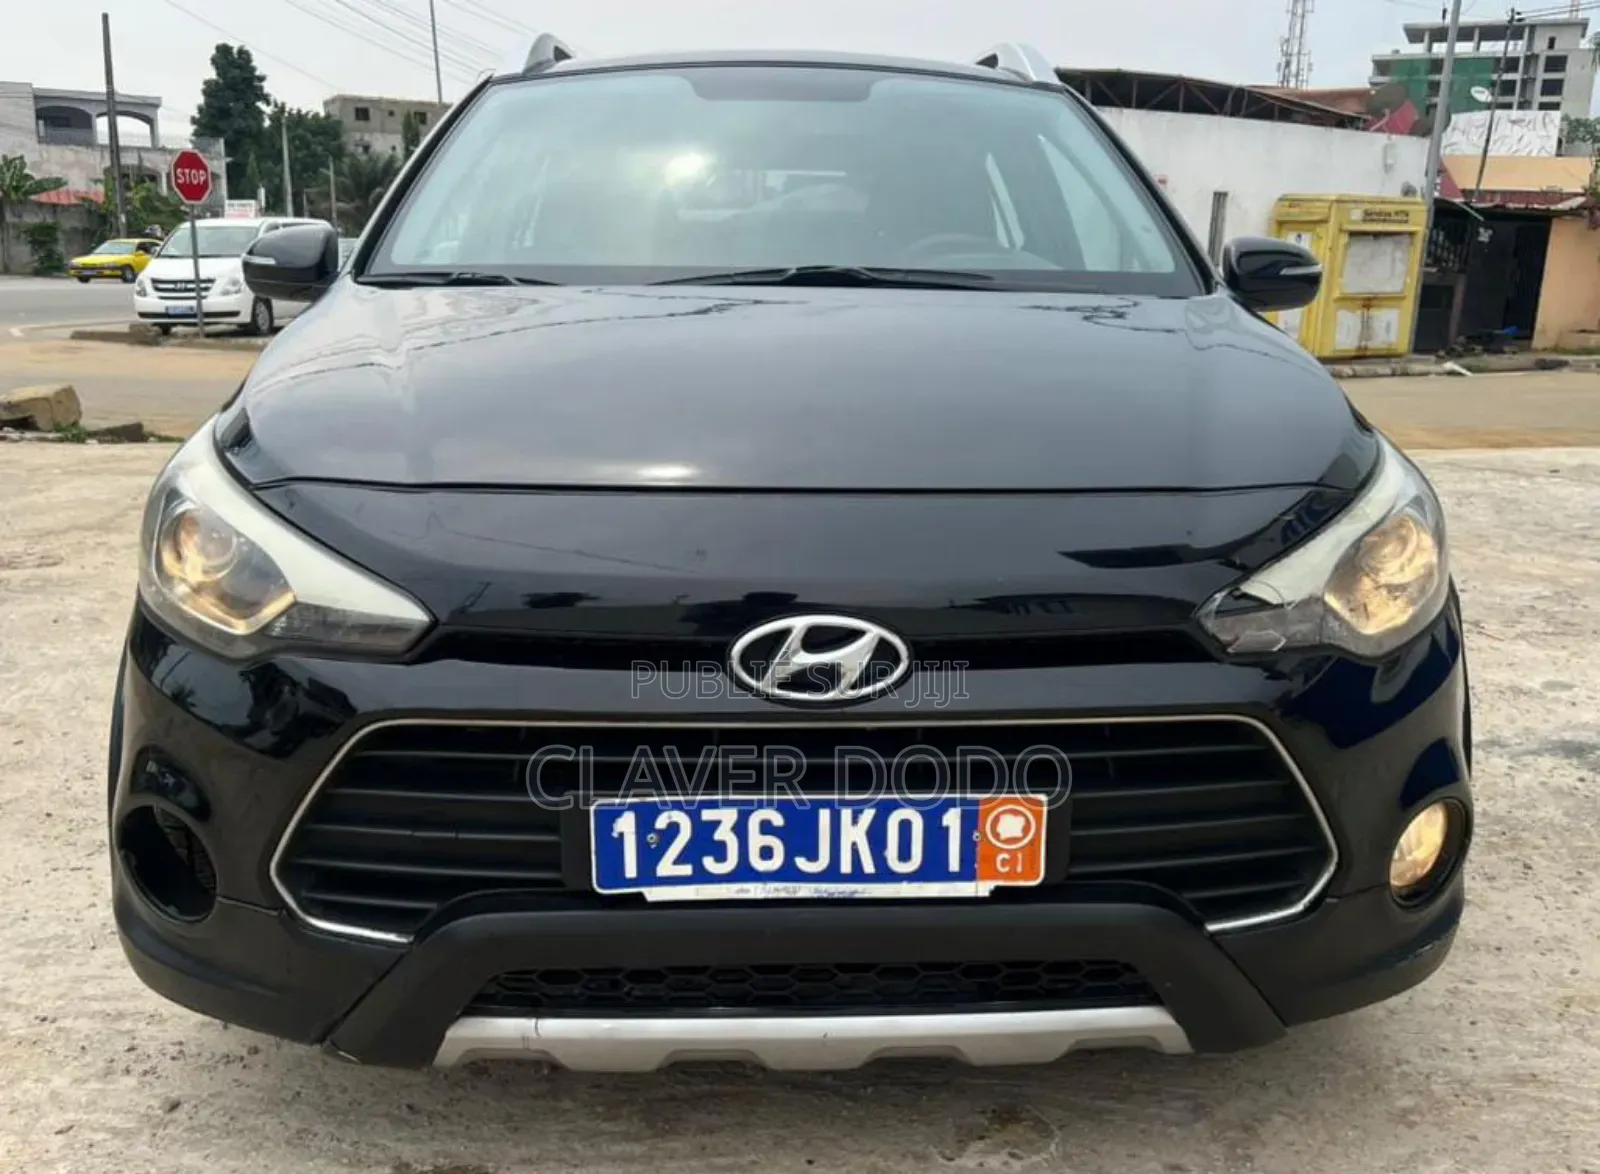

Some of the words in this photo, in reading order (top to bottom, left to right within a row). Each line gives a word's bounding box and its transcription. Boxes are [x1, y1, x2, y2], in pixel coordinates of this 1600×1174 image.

[176, 167, 207, 185] STOP
[611, 806, 962, 879] 1236JK01
[996, 851, 1023, 874] CI
